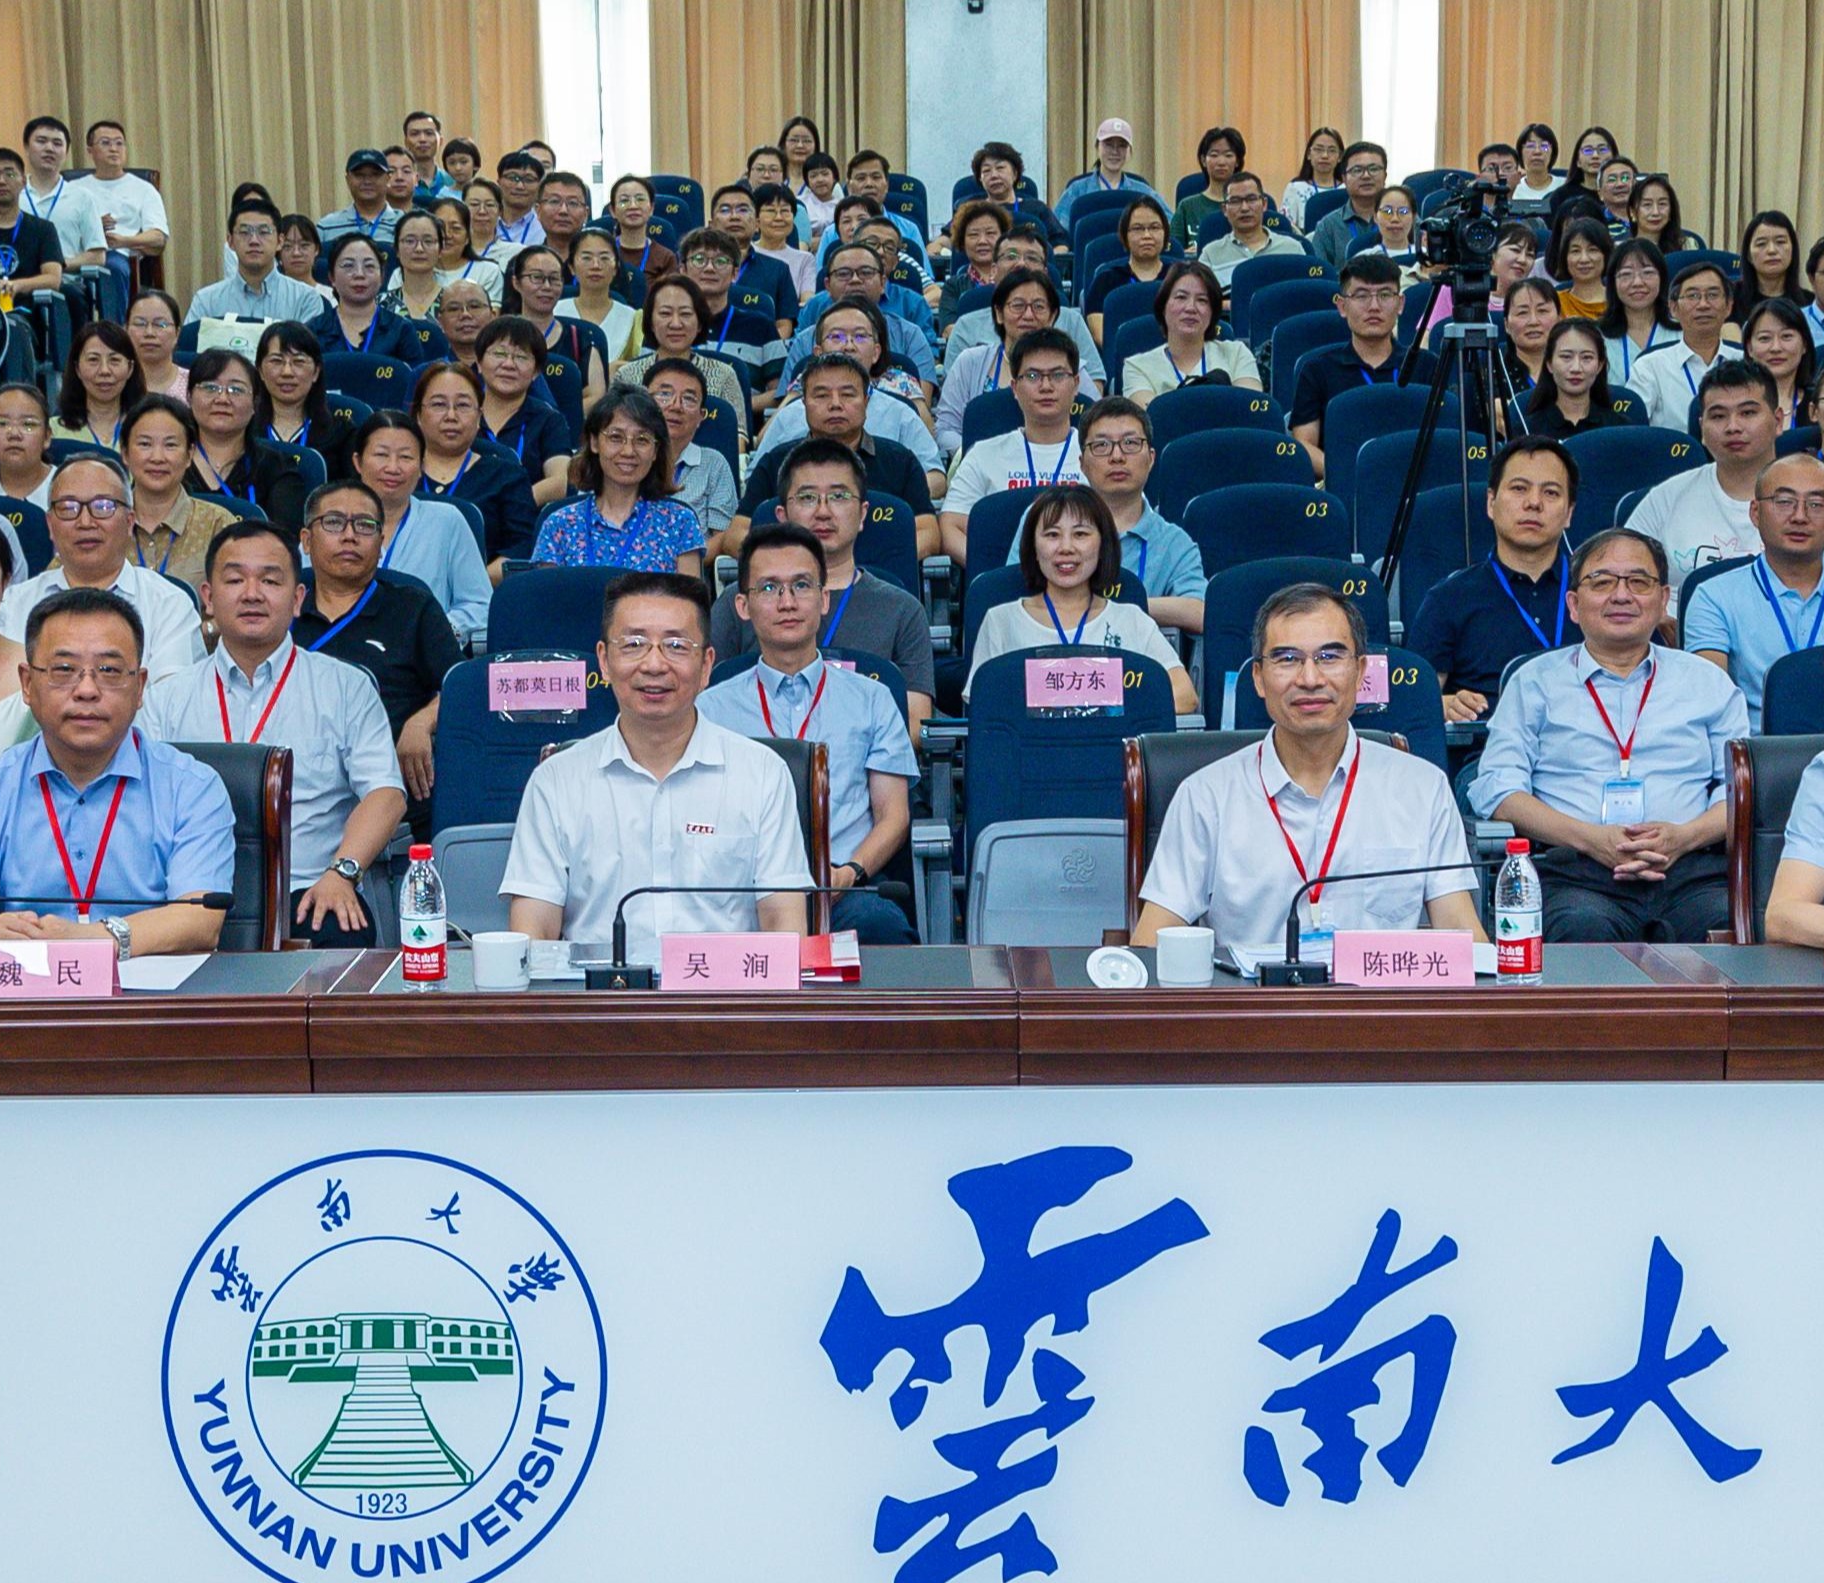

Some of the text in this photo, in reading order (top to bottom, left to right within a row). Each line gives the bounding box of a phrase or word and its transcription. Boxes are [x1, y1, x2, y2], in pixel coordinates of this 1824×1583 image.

[1308, 266, 1324, 277] 05
[743, 294, 760, 305] 04
[375, 366, 394, 379] 08
[546, 364, 563, 376] 06
[1250, 400, 1269, 412] 03
[1613, 400, 1632, 414] 07
[1276, 442, 1296, 456] 03
[1468, 445, 1487, 460] 05
[1670, 442, 1690, 457] 07
[872, 506, 895, 523] 02
[1306, 502, 1328, 518] 03
[7, 512, 23, 527] 10
[1343, 579, 1367, 596] 03
[1045, 671, 1106, 691] 邹方东
[1123, 671, 1143, 688] 01
[1392, 667, 1419, 686] 03
[1363, 950, 1449, 979] 陈晔光
[193, 1365, 576, 1578] YUNNAN UNIVERSITY
[355, 1492, 407, 1516] 1923
